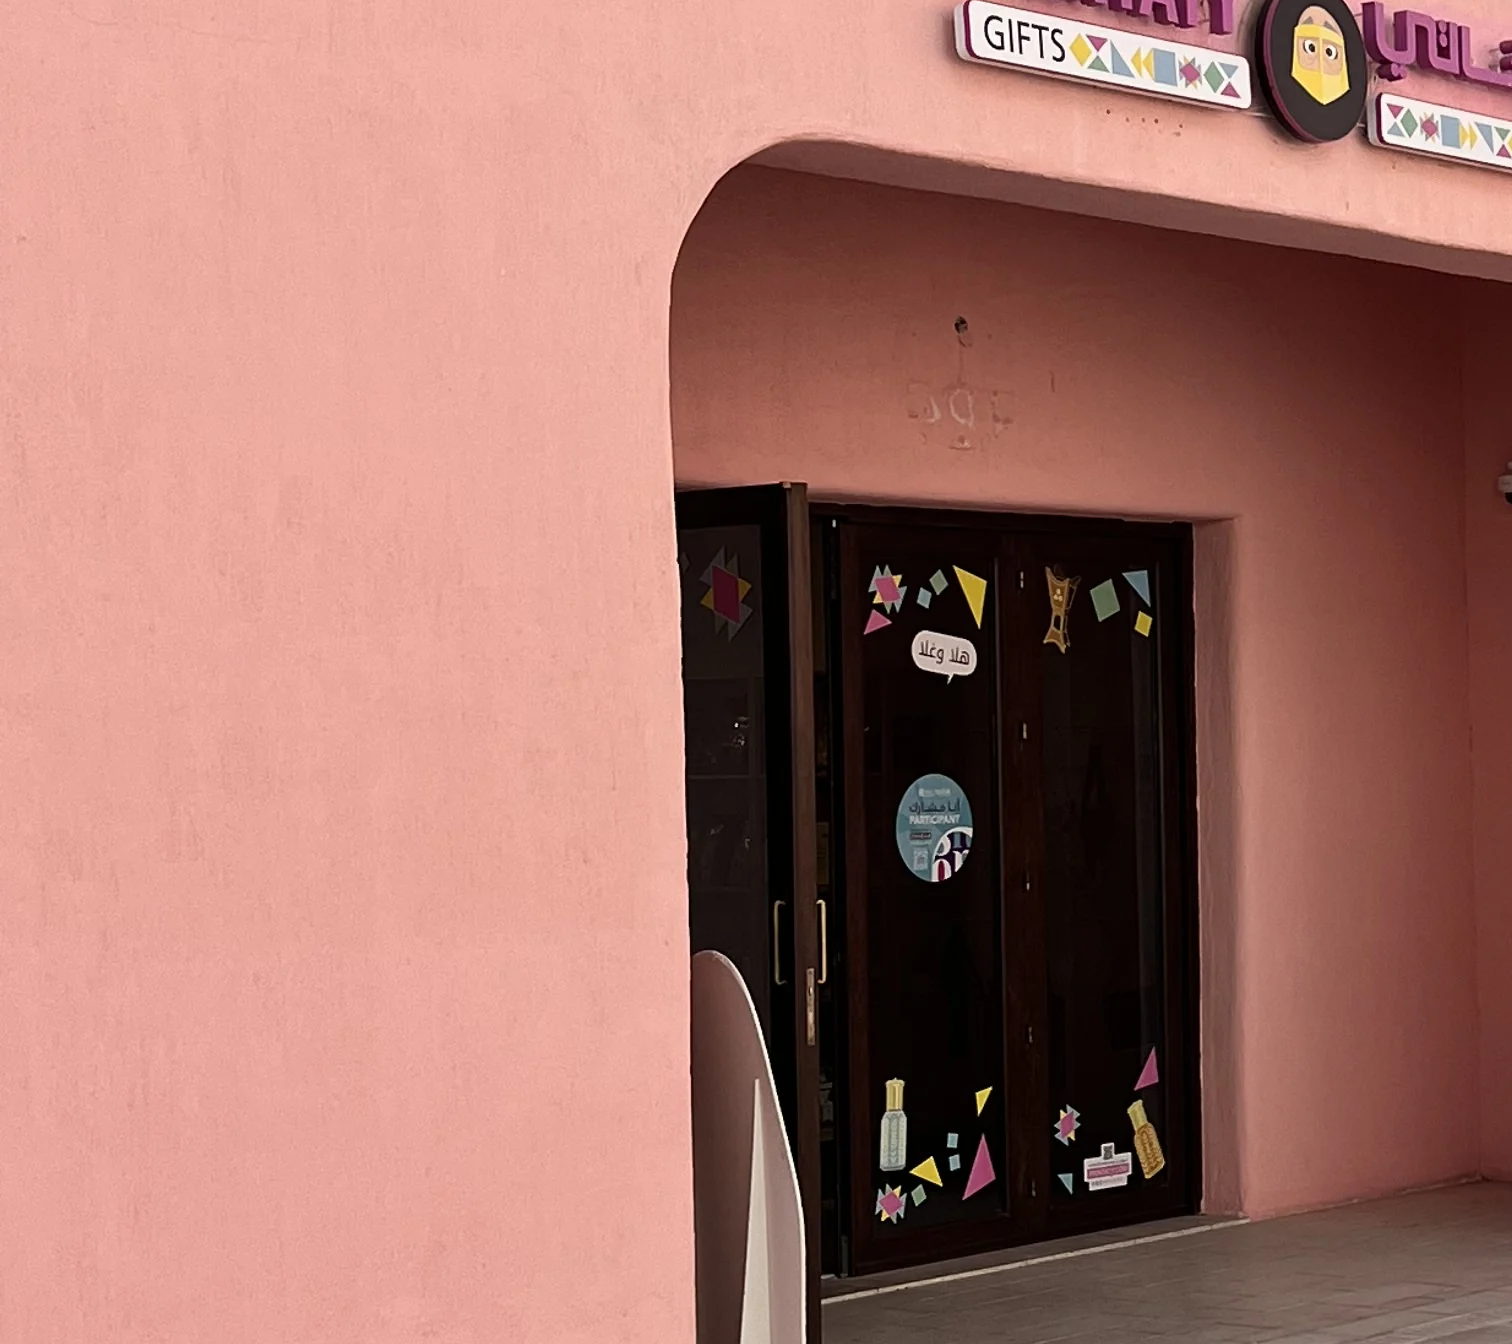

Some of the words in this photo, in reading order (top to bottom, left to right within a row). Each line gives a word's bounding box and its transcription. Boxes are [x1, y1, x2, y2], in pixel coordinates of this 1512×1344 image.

[983, 15, 1066, 63] GIFTS
[918, 639, 945, 665] وغلا
[948, 645, 970, 666] هلا
[908, 813, 961, 825] PARTICIPANT
